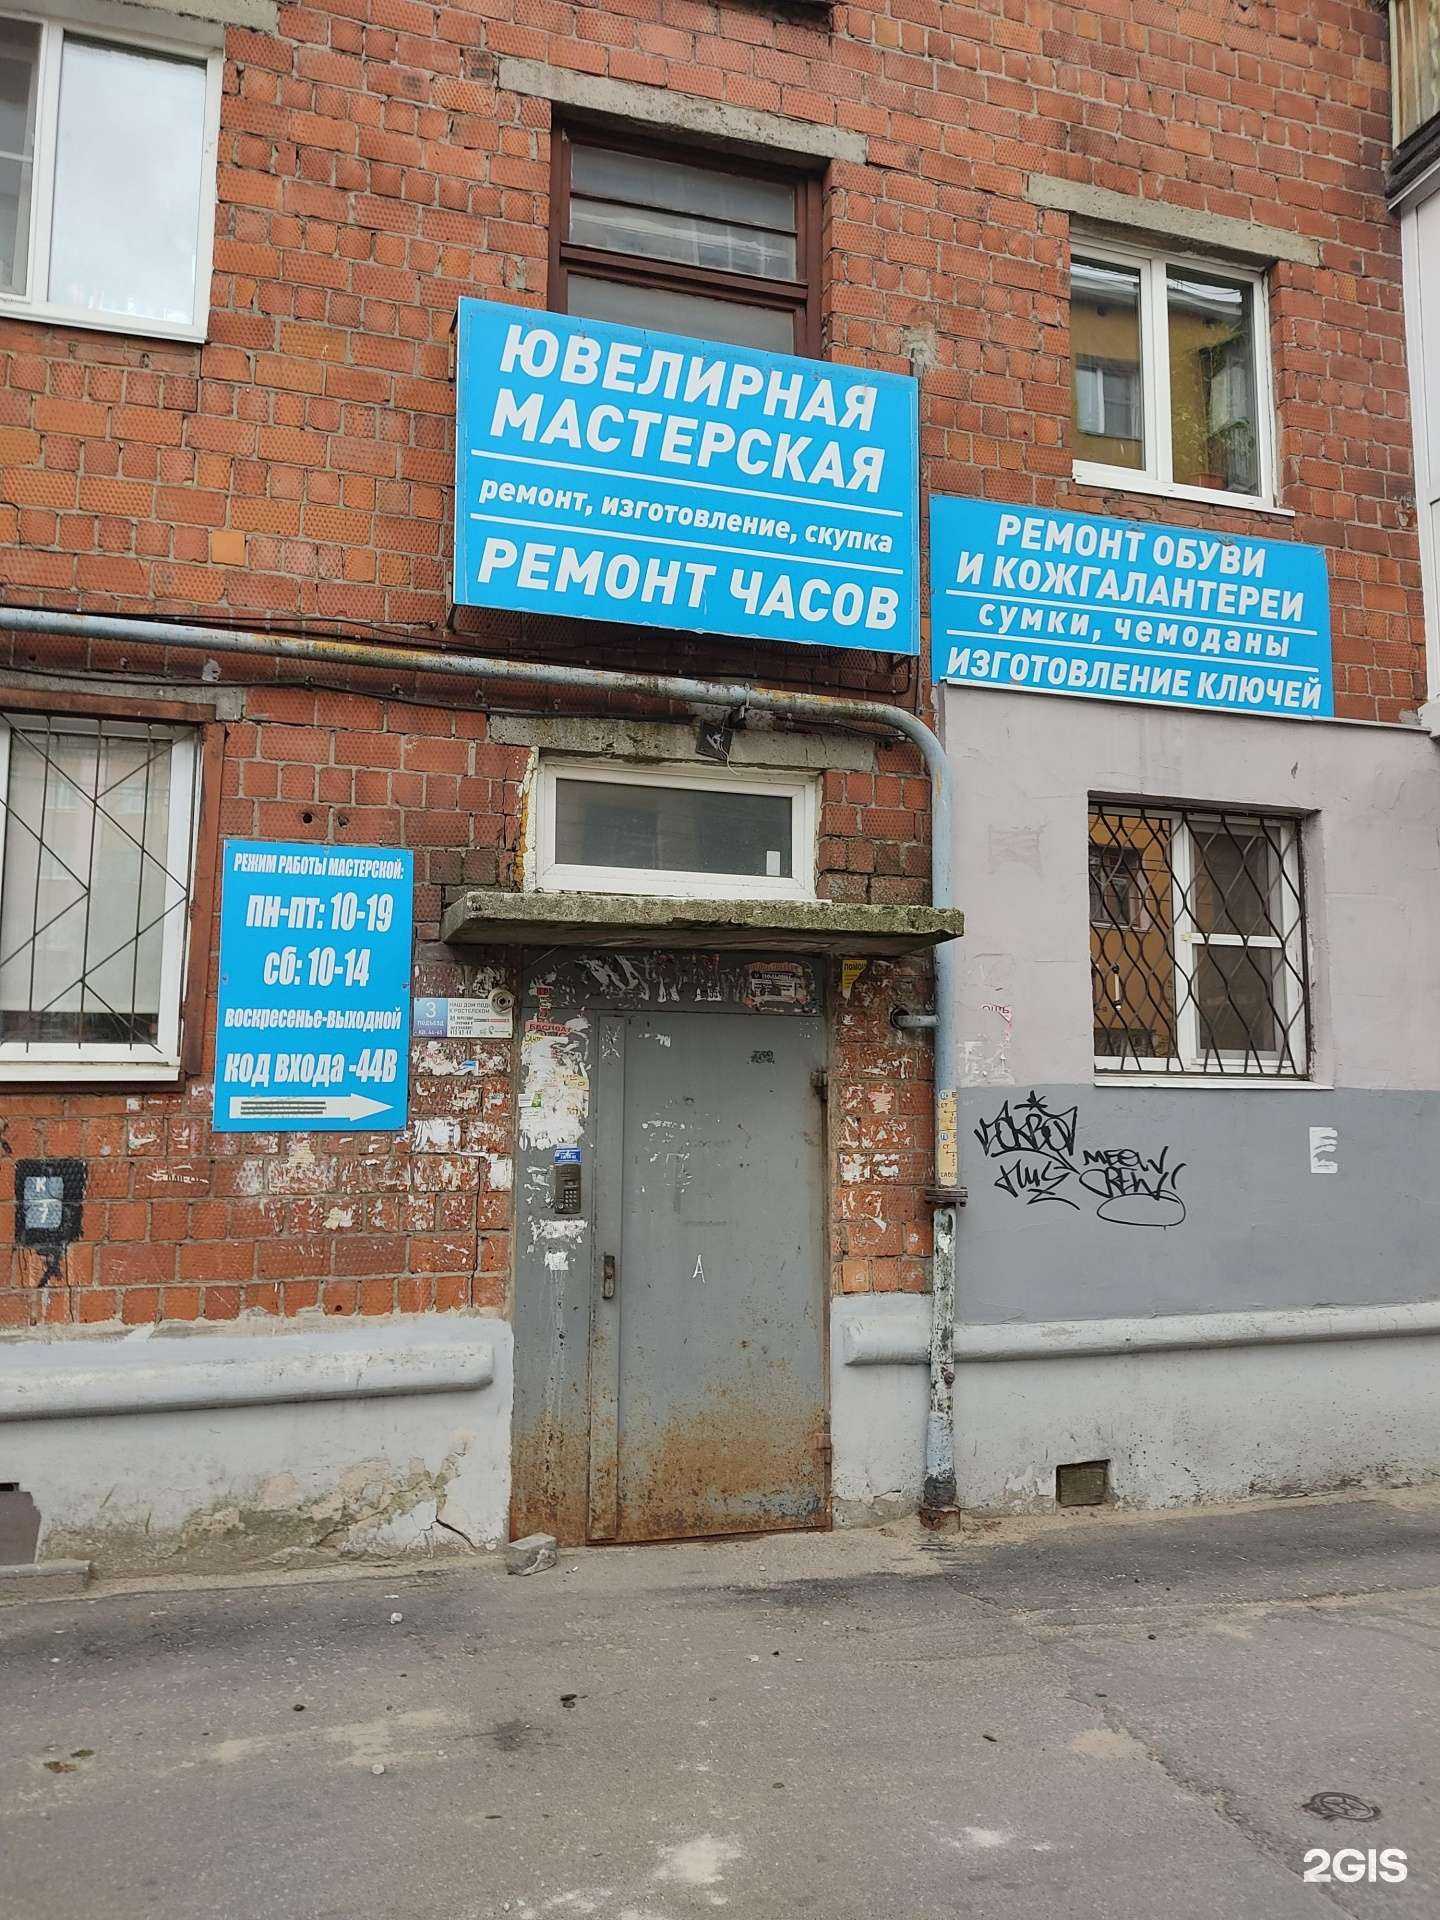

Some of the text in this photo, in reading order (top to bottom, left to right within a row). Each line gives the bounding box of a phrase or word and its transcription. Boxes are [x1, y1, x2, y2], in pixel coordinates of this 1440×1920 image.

[499, 324, 878, 432] ЮВЕЛИРНАЯ
[489, 388, 886, 493] МАСТЕРСКАЯ
[479, 477, 893, 554] ремонт, изготовление, скупка
[996, 514, 1266, 578] РЕМОНТ ОБУВИ
[476, 537, 899, 631] РЕМОНТ ЧАСОВ
[956, 551, 1304, 622] И КОЖГАЛАНТЕРЕИ
[978, 602, 1290, 658] сумки, чемоданы
[946, 646, 1322, 710] ИЗГОТОВЛЕНИЕ КЛЮЧЕЙ
[234, 853, 405, 880] РЕЖИМ РАБОТЫ МАСТЕРСКОЙ:
[330, 892, 394, 932] 10-19
[308, 947, 371, 987] 10-14
[425, 1001, 436, 1018] 3
